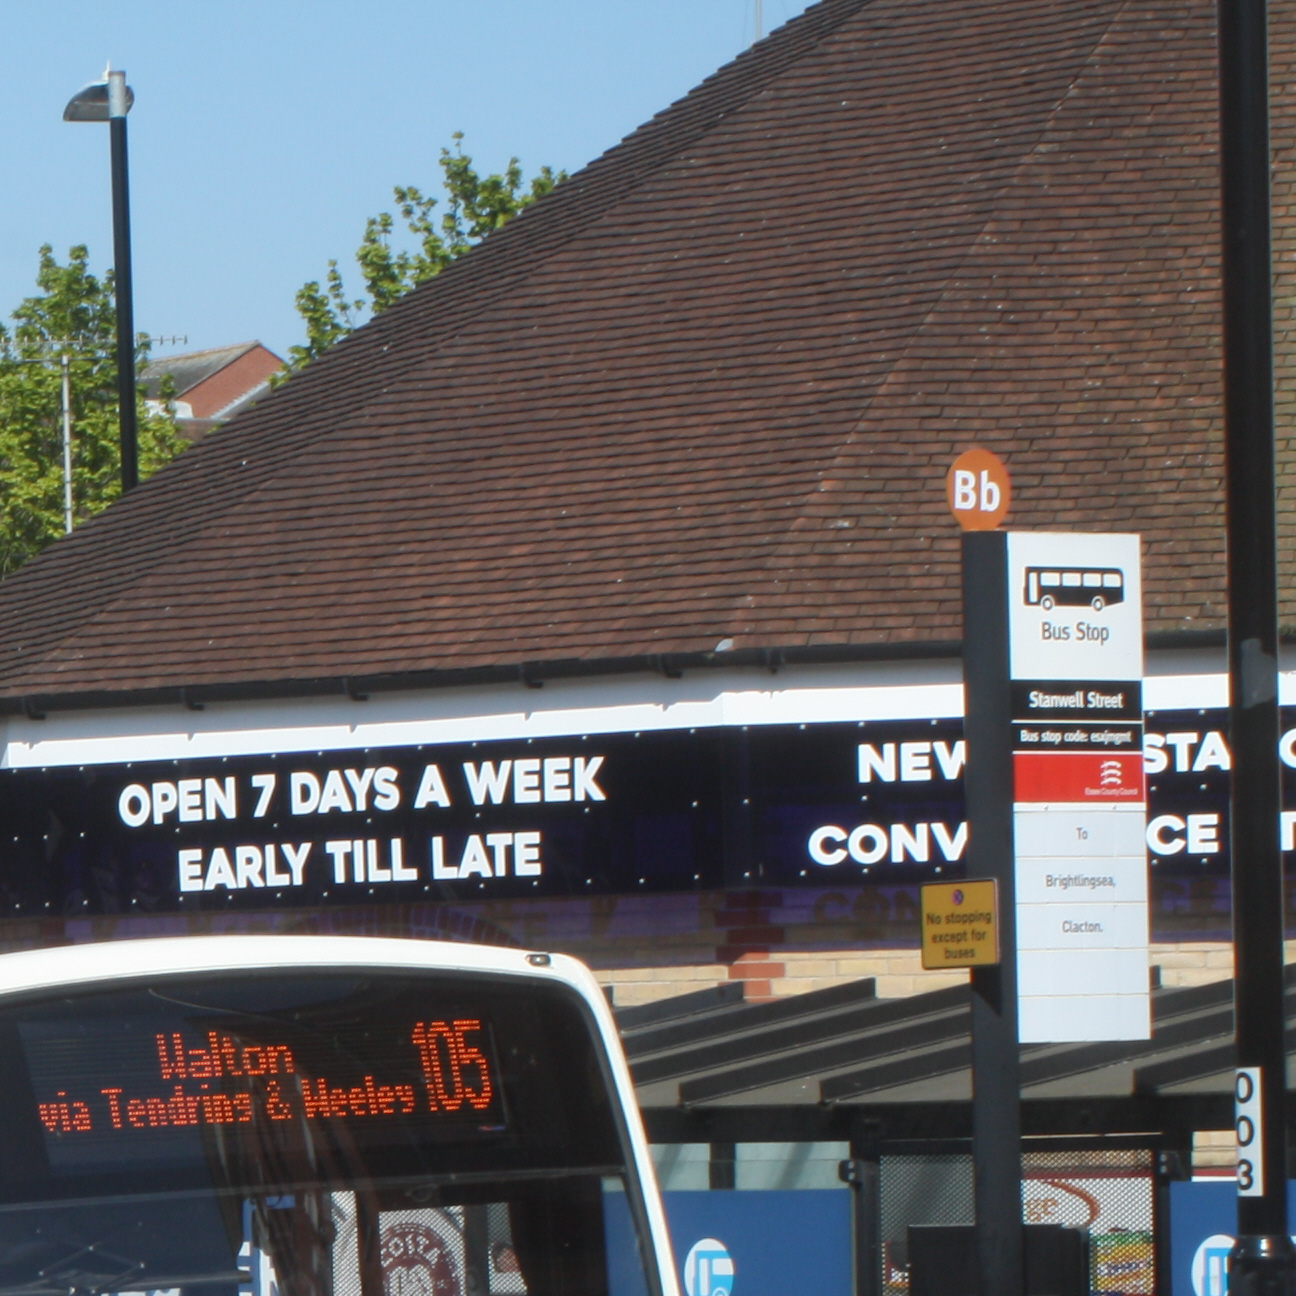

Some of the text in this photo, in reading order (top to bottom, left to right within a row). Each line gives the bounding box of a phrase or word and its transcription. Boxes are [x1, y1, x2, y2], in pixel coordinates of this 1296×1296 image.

[954, 470, 1000, 512] Bb
[1041, 622, 1110, 646] Bus Stop
[1029, 690, 1124, 709] Stanwell Street
[1020, 730, 1039, 743] Bus
[1041, 730, 1062, 745] stop
[1064, 730, 1088, 743] code:
[118, 756, 607, 828] OPEN 7 DAYS A WEEK
[1075, 827, 1089, 840] To
[178, 831, 542, 893] EARLY TILL LATE
[1045, 873, 1117, 892] Brightlingsea,
[927, 911, 992, 926] No stopping
[1061, 920, 1104, 934] Clacton.
[932, 929, 987, 944] except for
[944, 947, 976, 960] buses
[155, 1031, 294, 1080] Walton
[412, 1019, 492, 1112] 105
[38, 1091, 92, 1132] via
[267, 1081, 292, 1121] &
